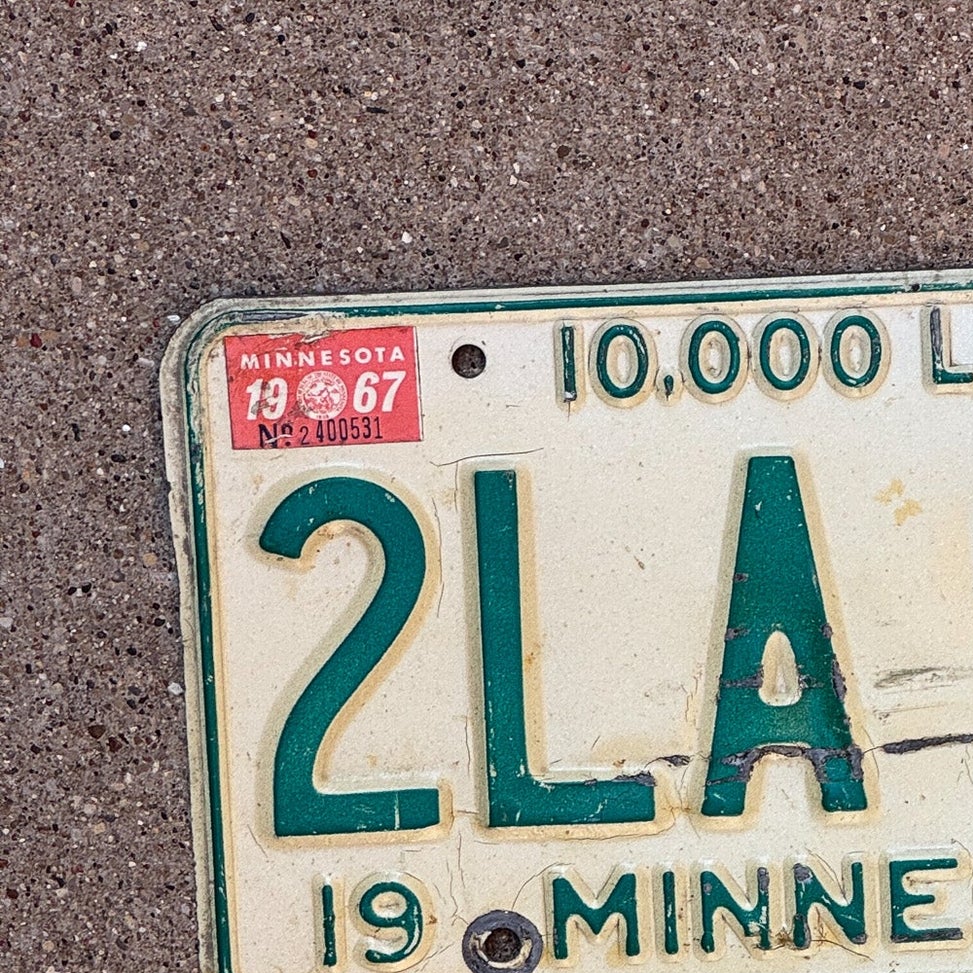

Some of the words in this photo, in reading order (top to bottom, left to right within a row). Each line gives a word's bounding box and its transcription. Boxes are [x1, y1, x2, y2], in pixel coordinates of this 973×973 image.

[240, 346, 406, 370] MINNESOTA
[245, 377, 289, 421] 19
[352, 370, 407, 415] 67
[258, 455, 868, 838] 2LA
[321, 881, 426, 968] 19
